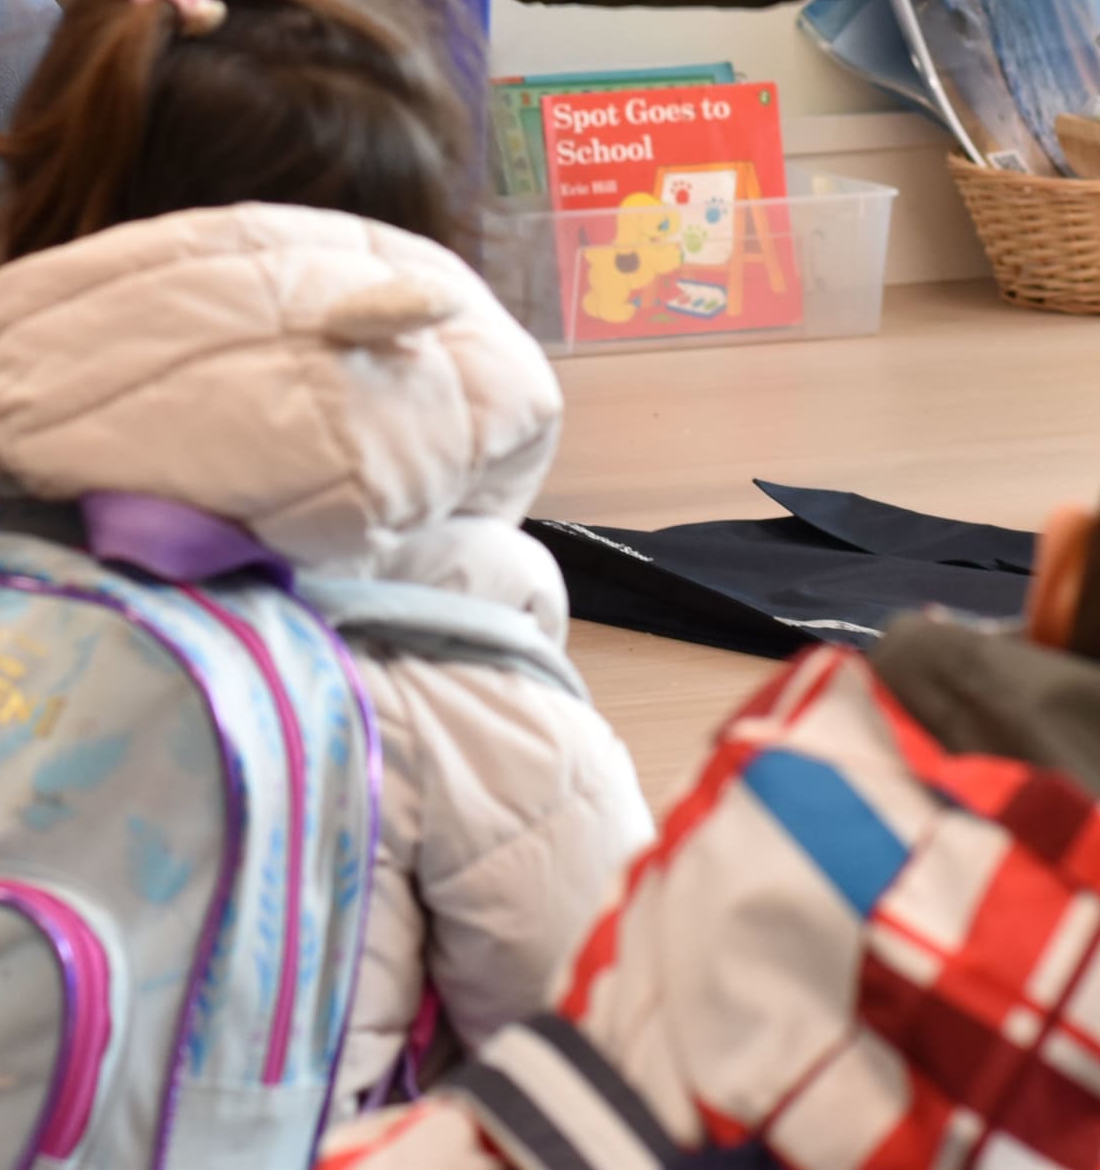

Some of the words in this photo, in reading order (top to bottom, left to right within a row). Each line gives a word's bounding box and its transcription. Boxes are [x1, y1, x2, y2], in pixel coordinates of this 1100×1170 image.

[553, 102, 618, 134] Spot
[625, 97, 696, 125] Goes
[701, 98, 731, 121] to
[556, 134, 655, 166] School
[560, 182, 589, 197] Eric
[592, 180, 618, 195] Hill
